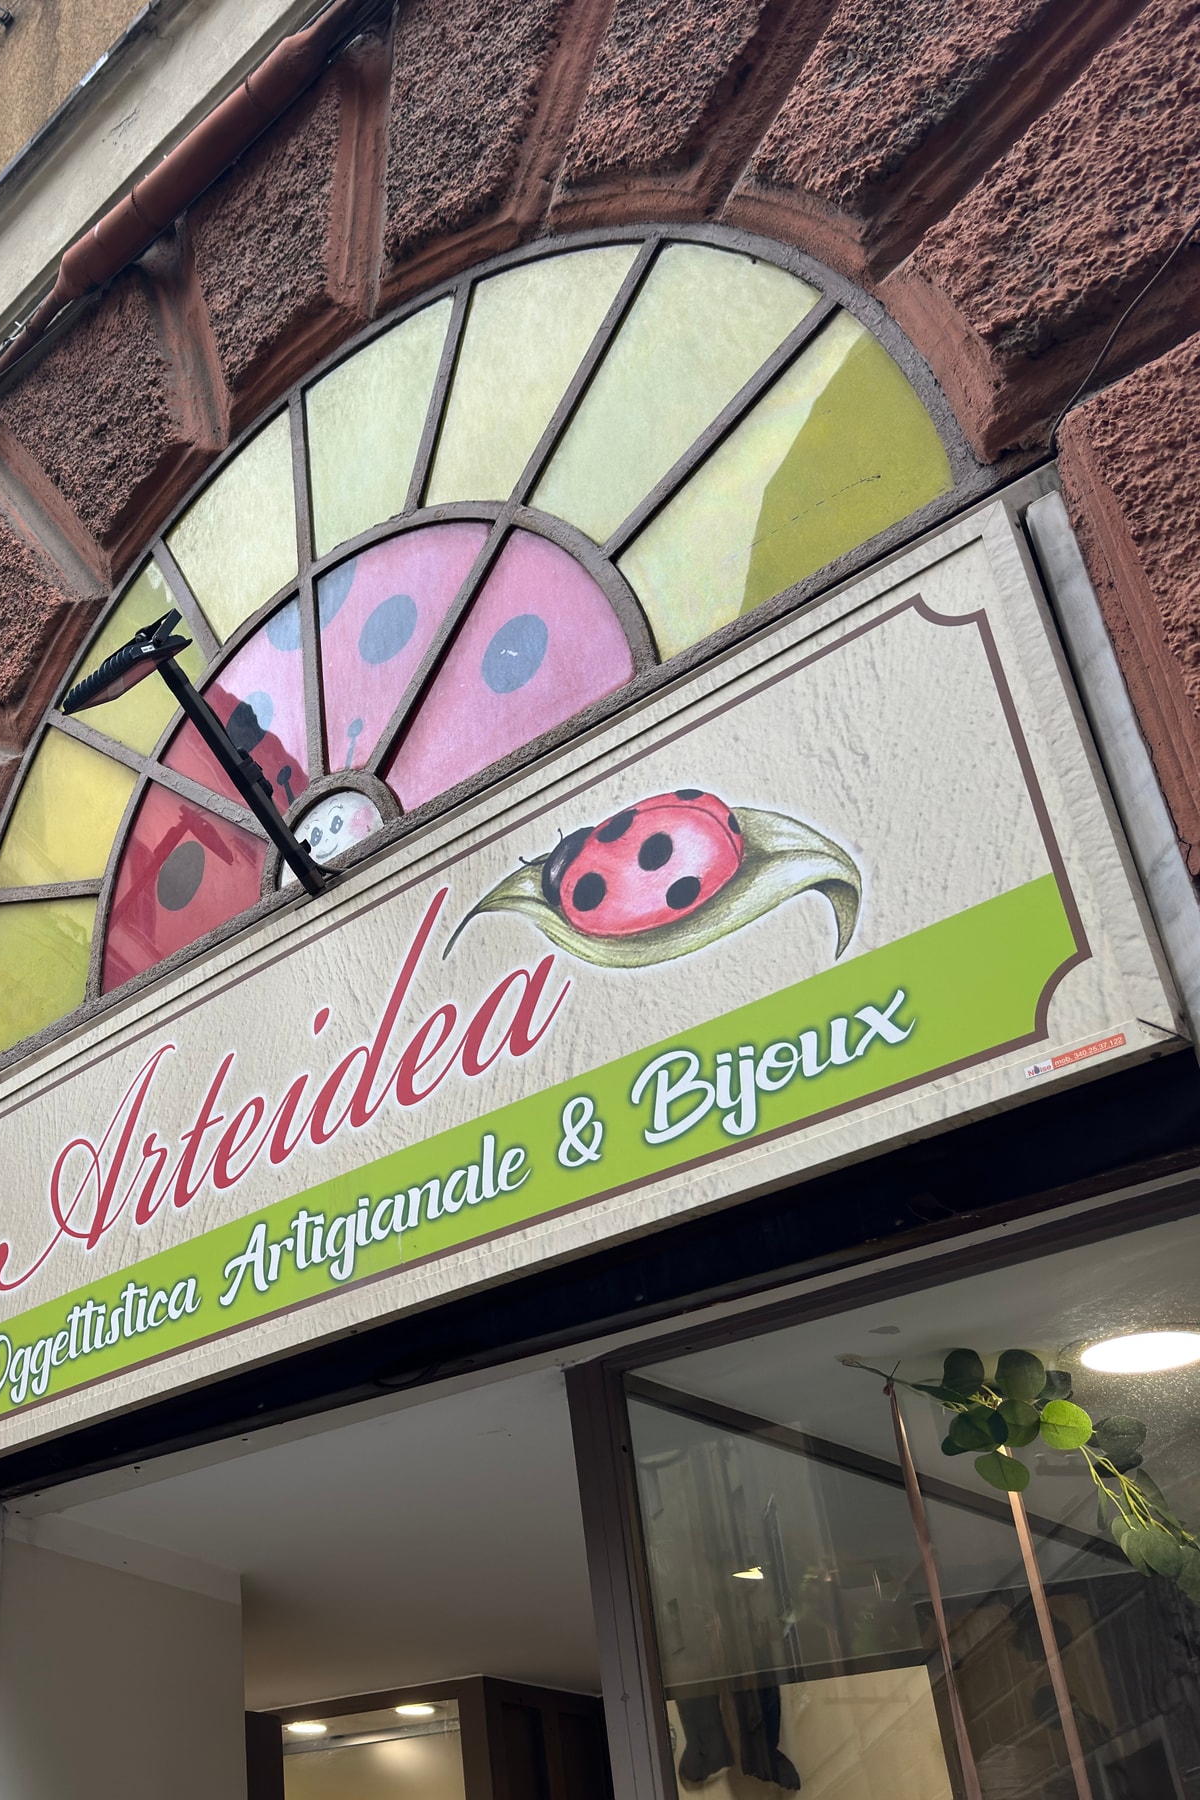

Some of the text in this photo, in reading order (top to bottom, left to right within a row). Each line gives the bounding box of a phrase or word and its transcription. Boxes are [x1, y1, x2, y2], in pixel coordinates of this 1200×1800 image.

[219, 1135, 531, 1306] Artigianale
[558, 1096, 604, 1168] &
[631, 989, 916, 1145] Bijoux
